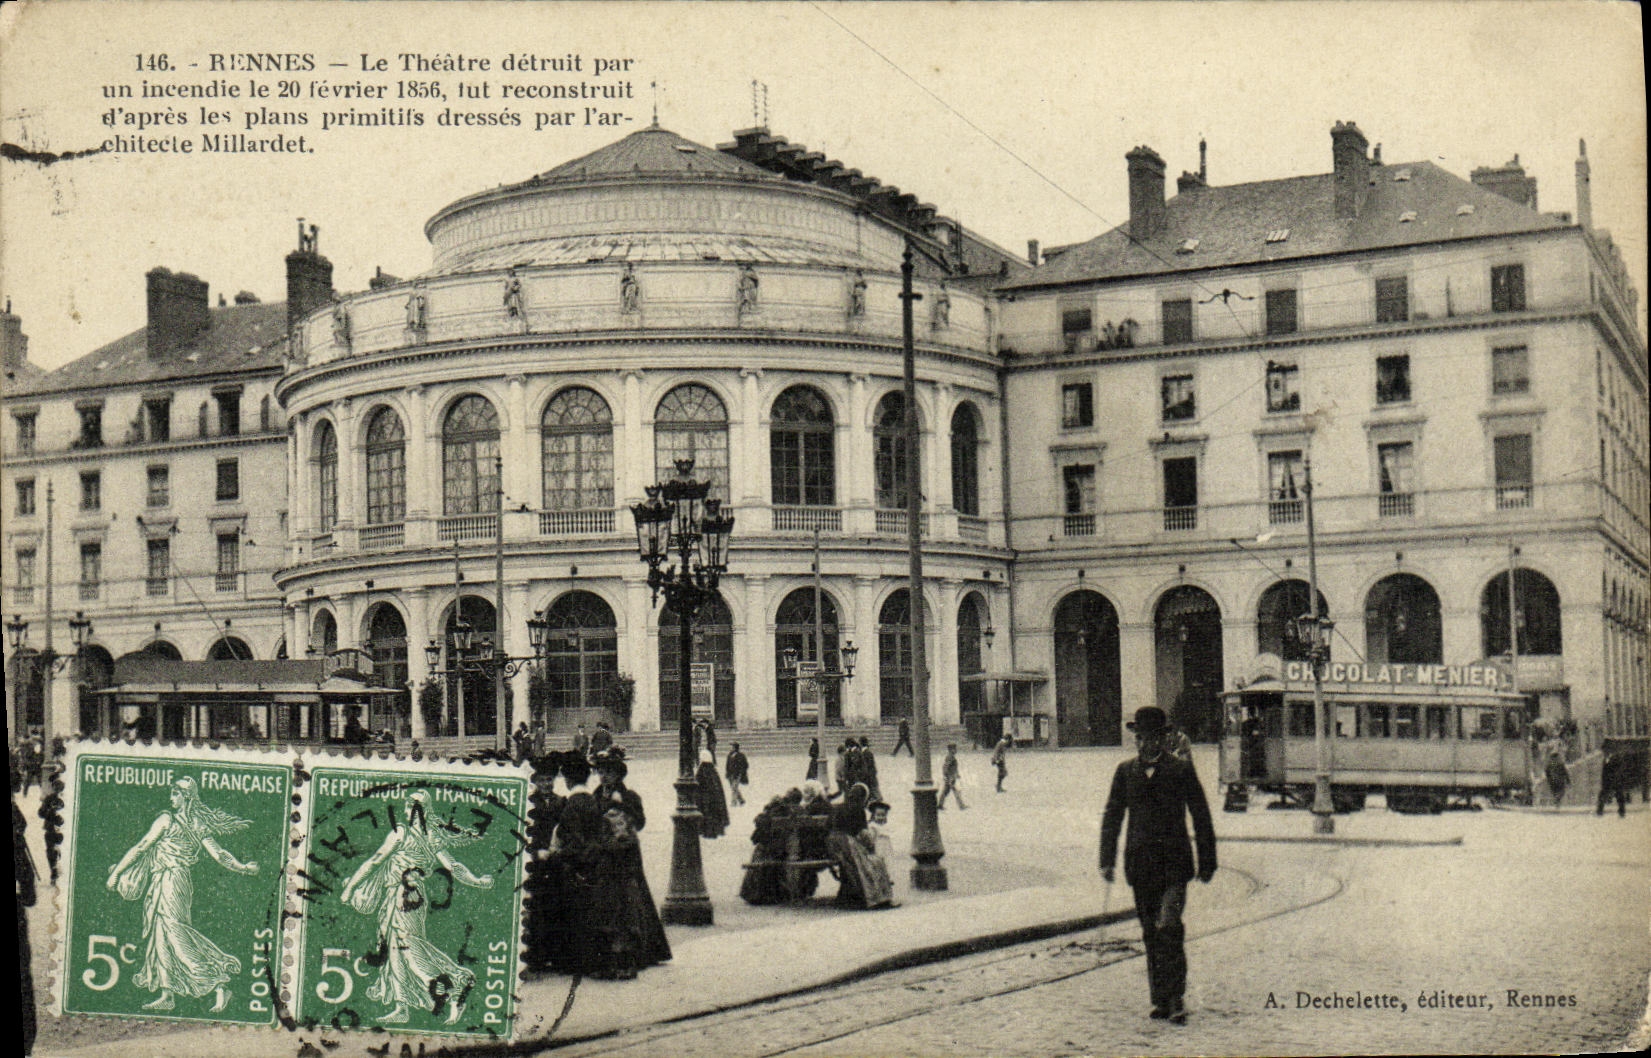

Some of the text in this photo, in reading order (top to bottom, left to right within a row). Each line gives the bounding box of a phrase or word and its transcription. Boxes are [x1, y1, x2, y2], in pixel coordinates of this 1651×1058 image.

[201, 771, 283, 794] FRANÇAISE
[250, 927, 274, 1012] POSTES
[483, 940, 508, 1024] POSTES
